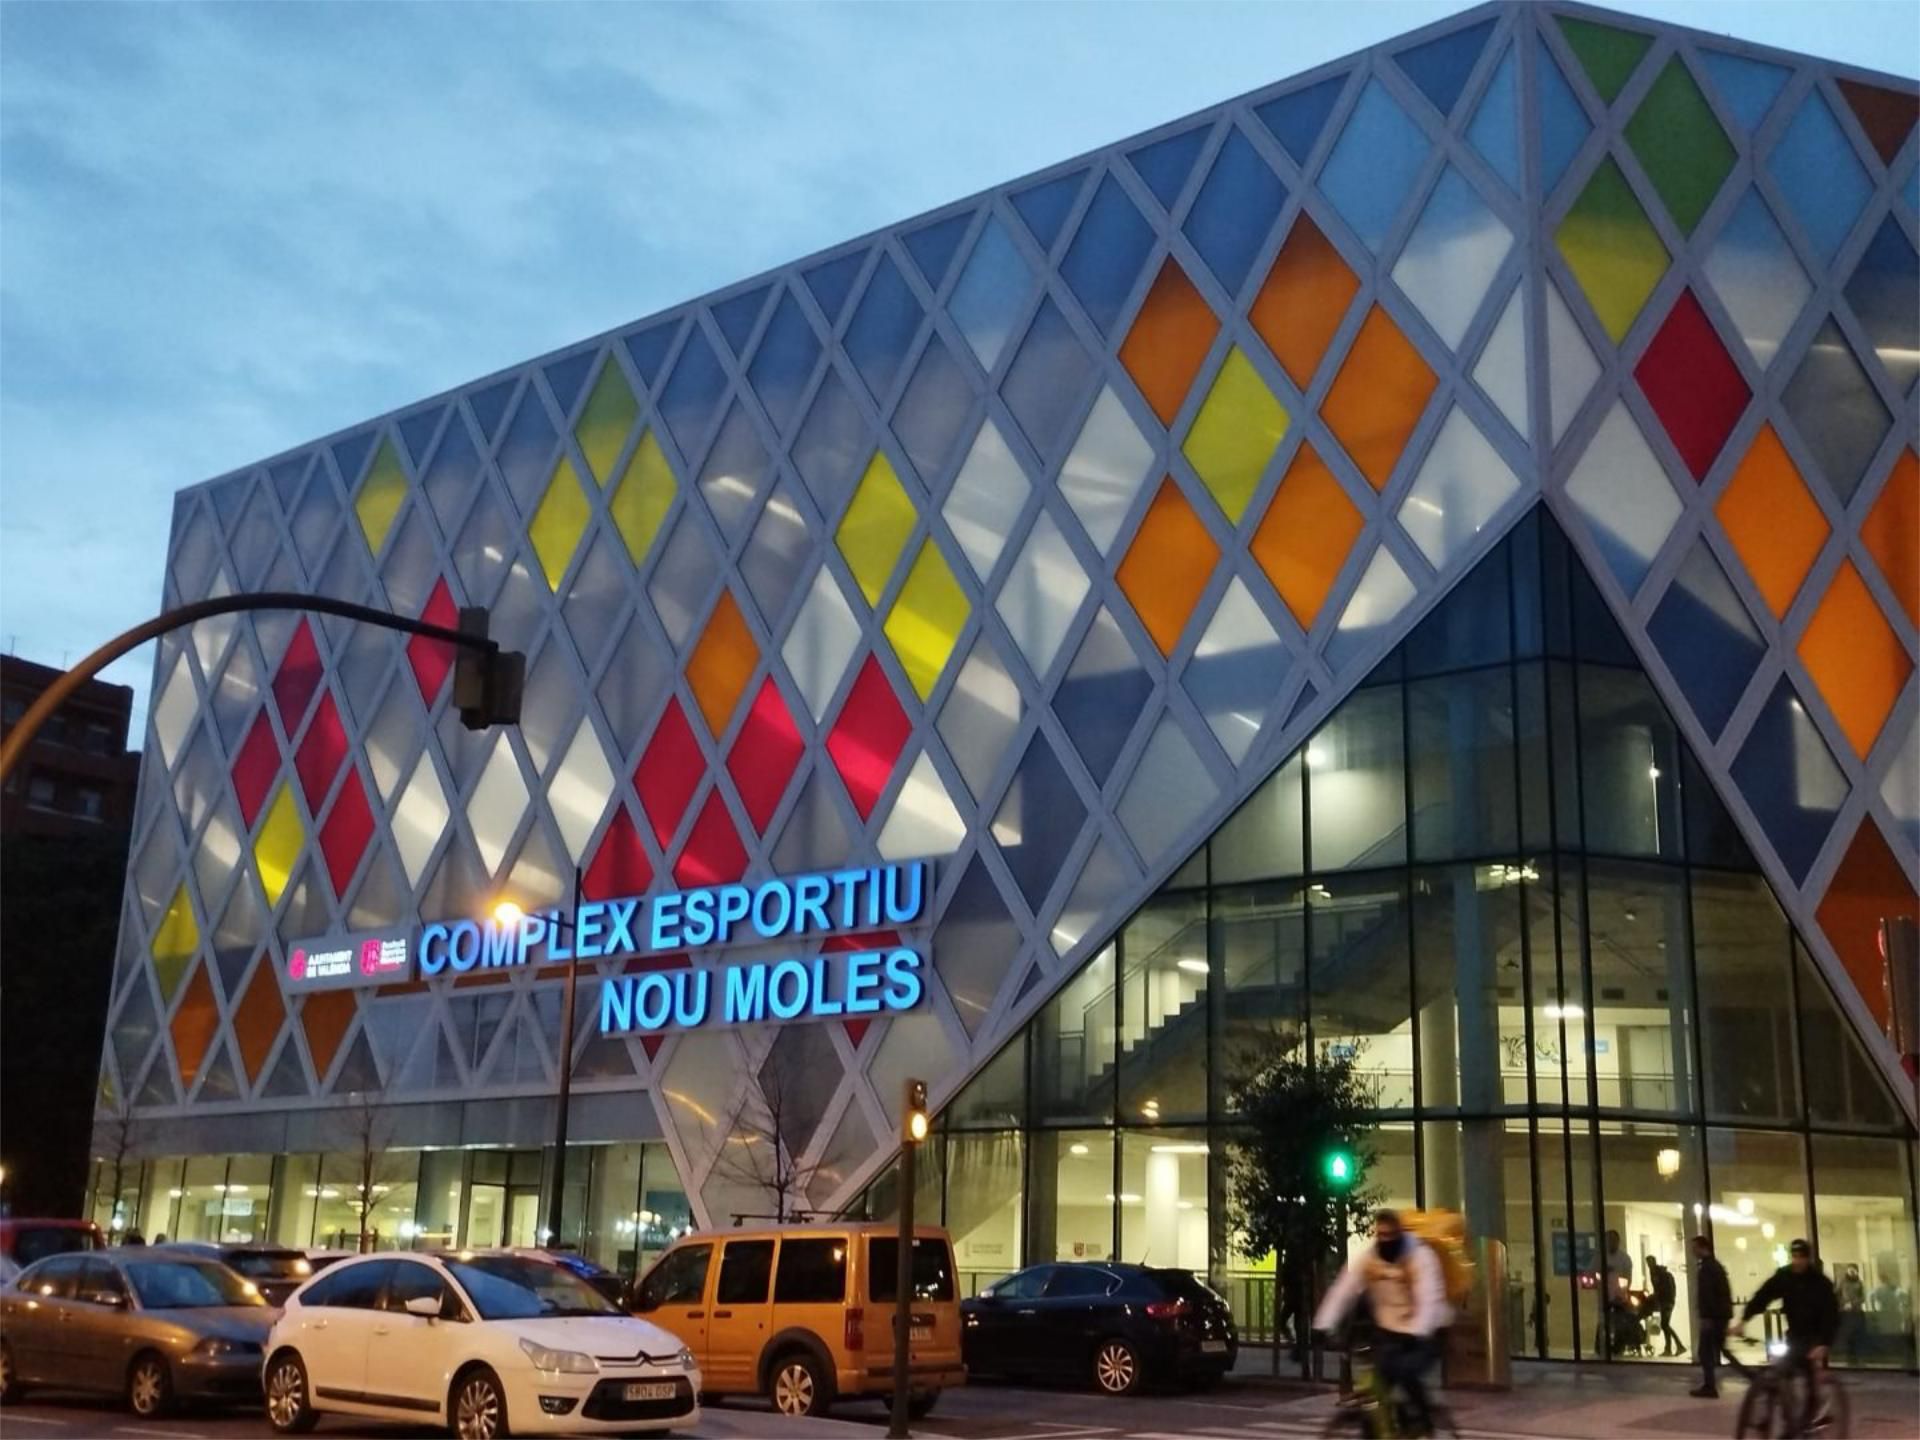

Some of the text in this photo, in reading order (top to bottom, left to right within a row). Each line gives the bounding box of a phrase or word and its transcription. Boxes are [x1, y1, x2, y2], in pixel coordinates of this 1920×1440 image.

[419, 863, 923, 975] COMPLEX ESPORTIU
[600, 949, 922, 1034] NOU MOLES
